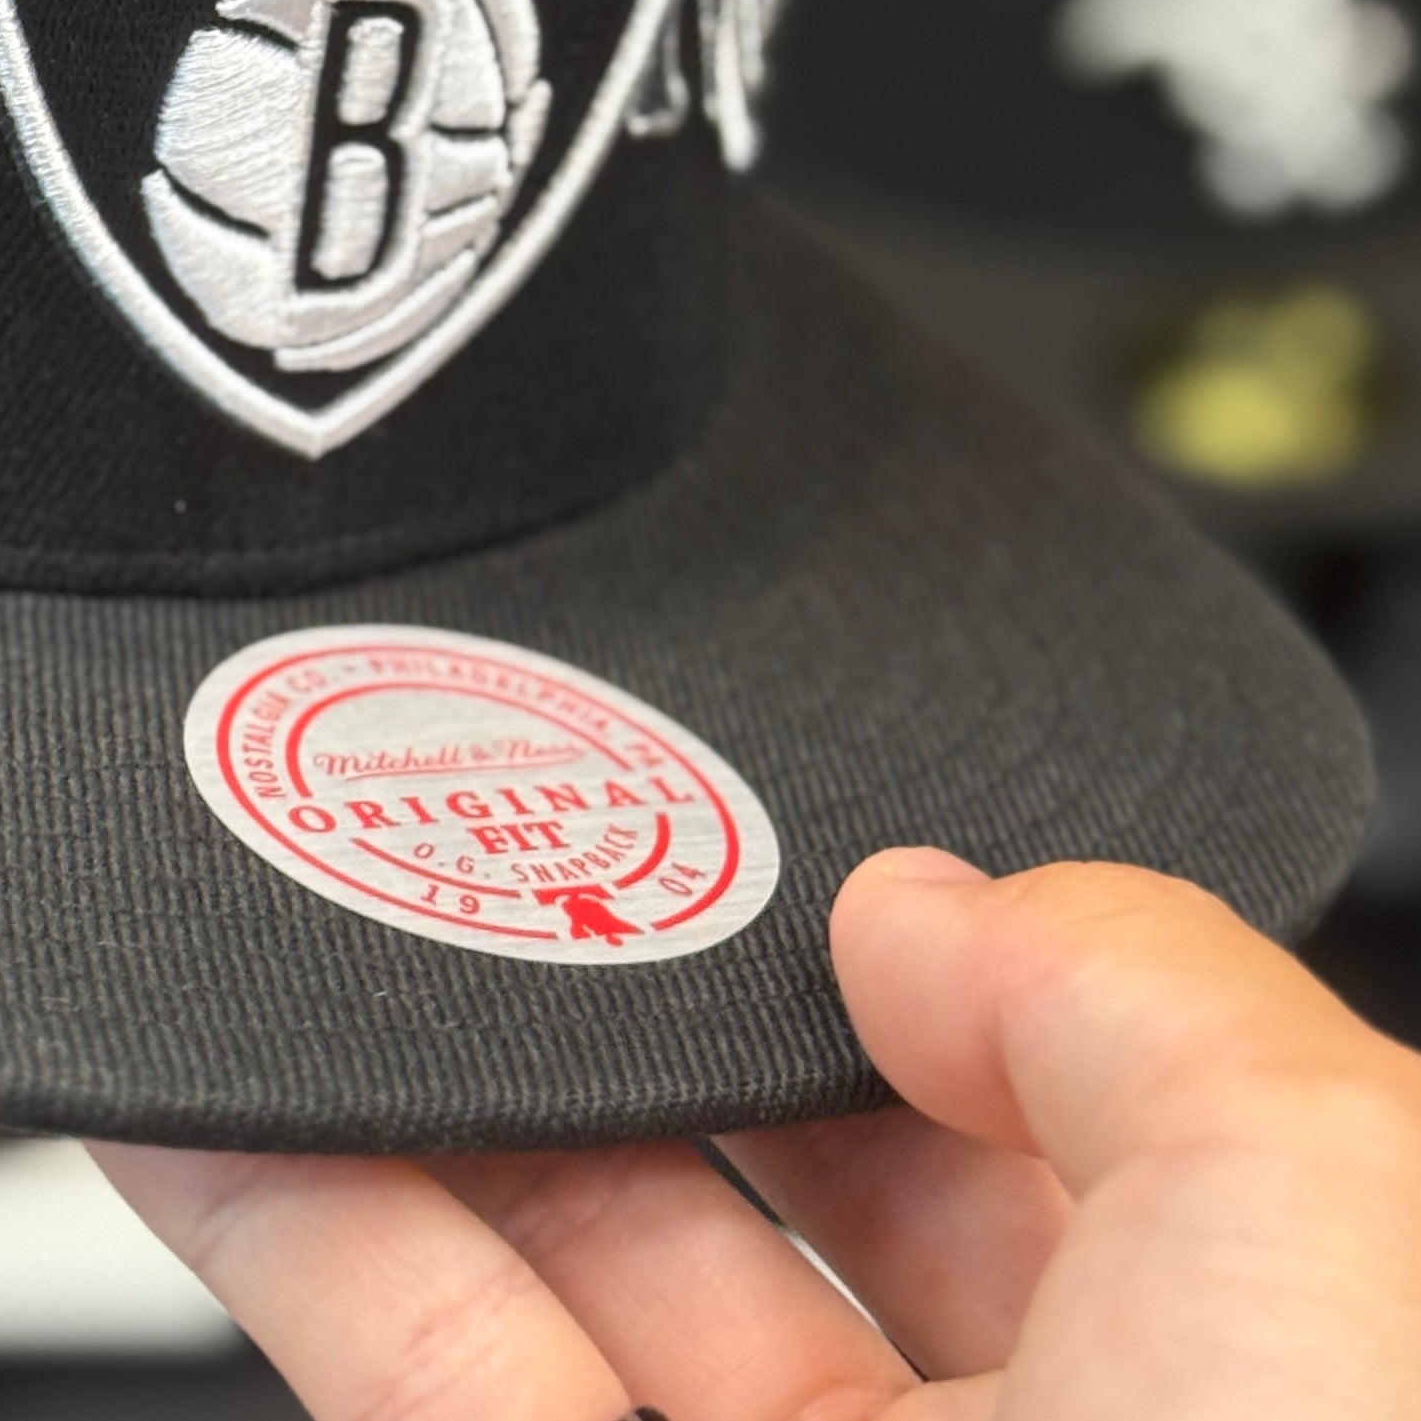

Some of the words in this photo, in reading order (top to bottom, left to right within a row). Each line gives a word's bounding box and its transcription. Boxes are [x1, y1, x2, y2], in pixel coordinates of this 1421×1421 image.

[242, 692, 291, 801] NOSTALGIA
[312, 745, 463, 777] Mitchell
[287, 776, 694, 834] ORIGINAL
[413, 842, 492, 879] O.G.
[511, 824, 639, 883] SNAPBACK
[467, 820, 572, 855] FIT
[420, 883, 481, 915] 19
[657, 862, 707, 897] 04
